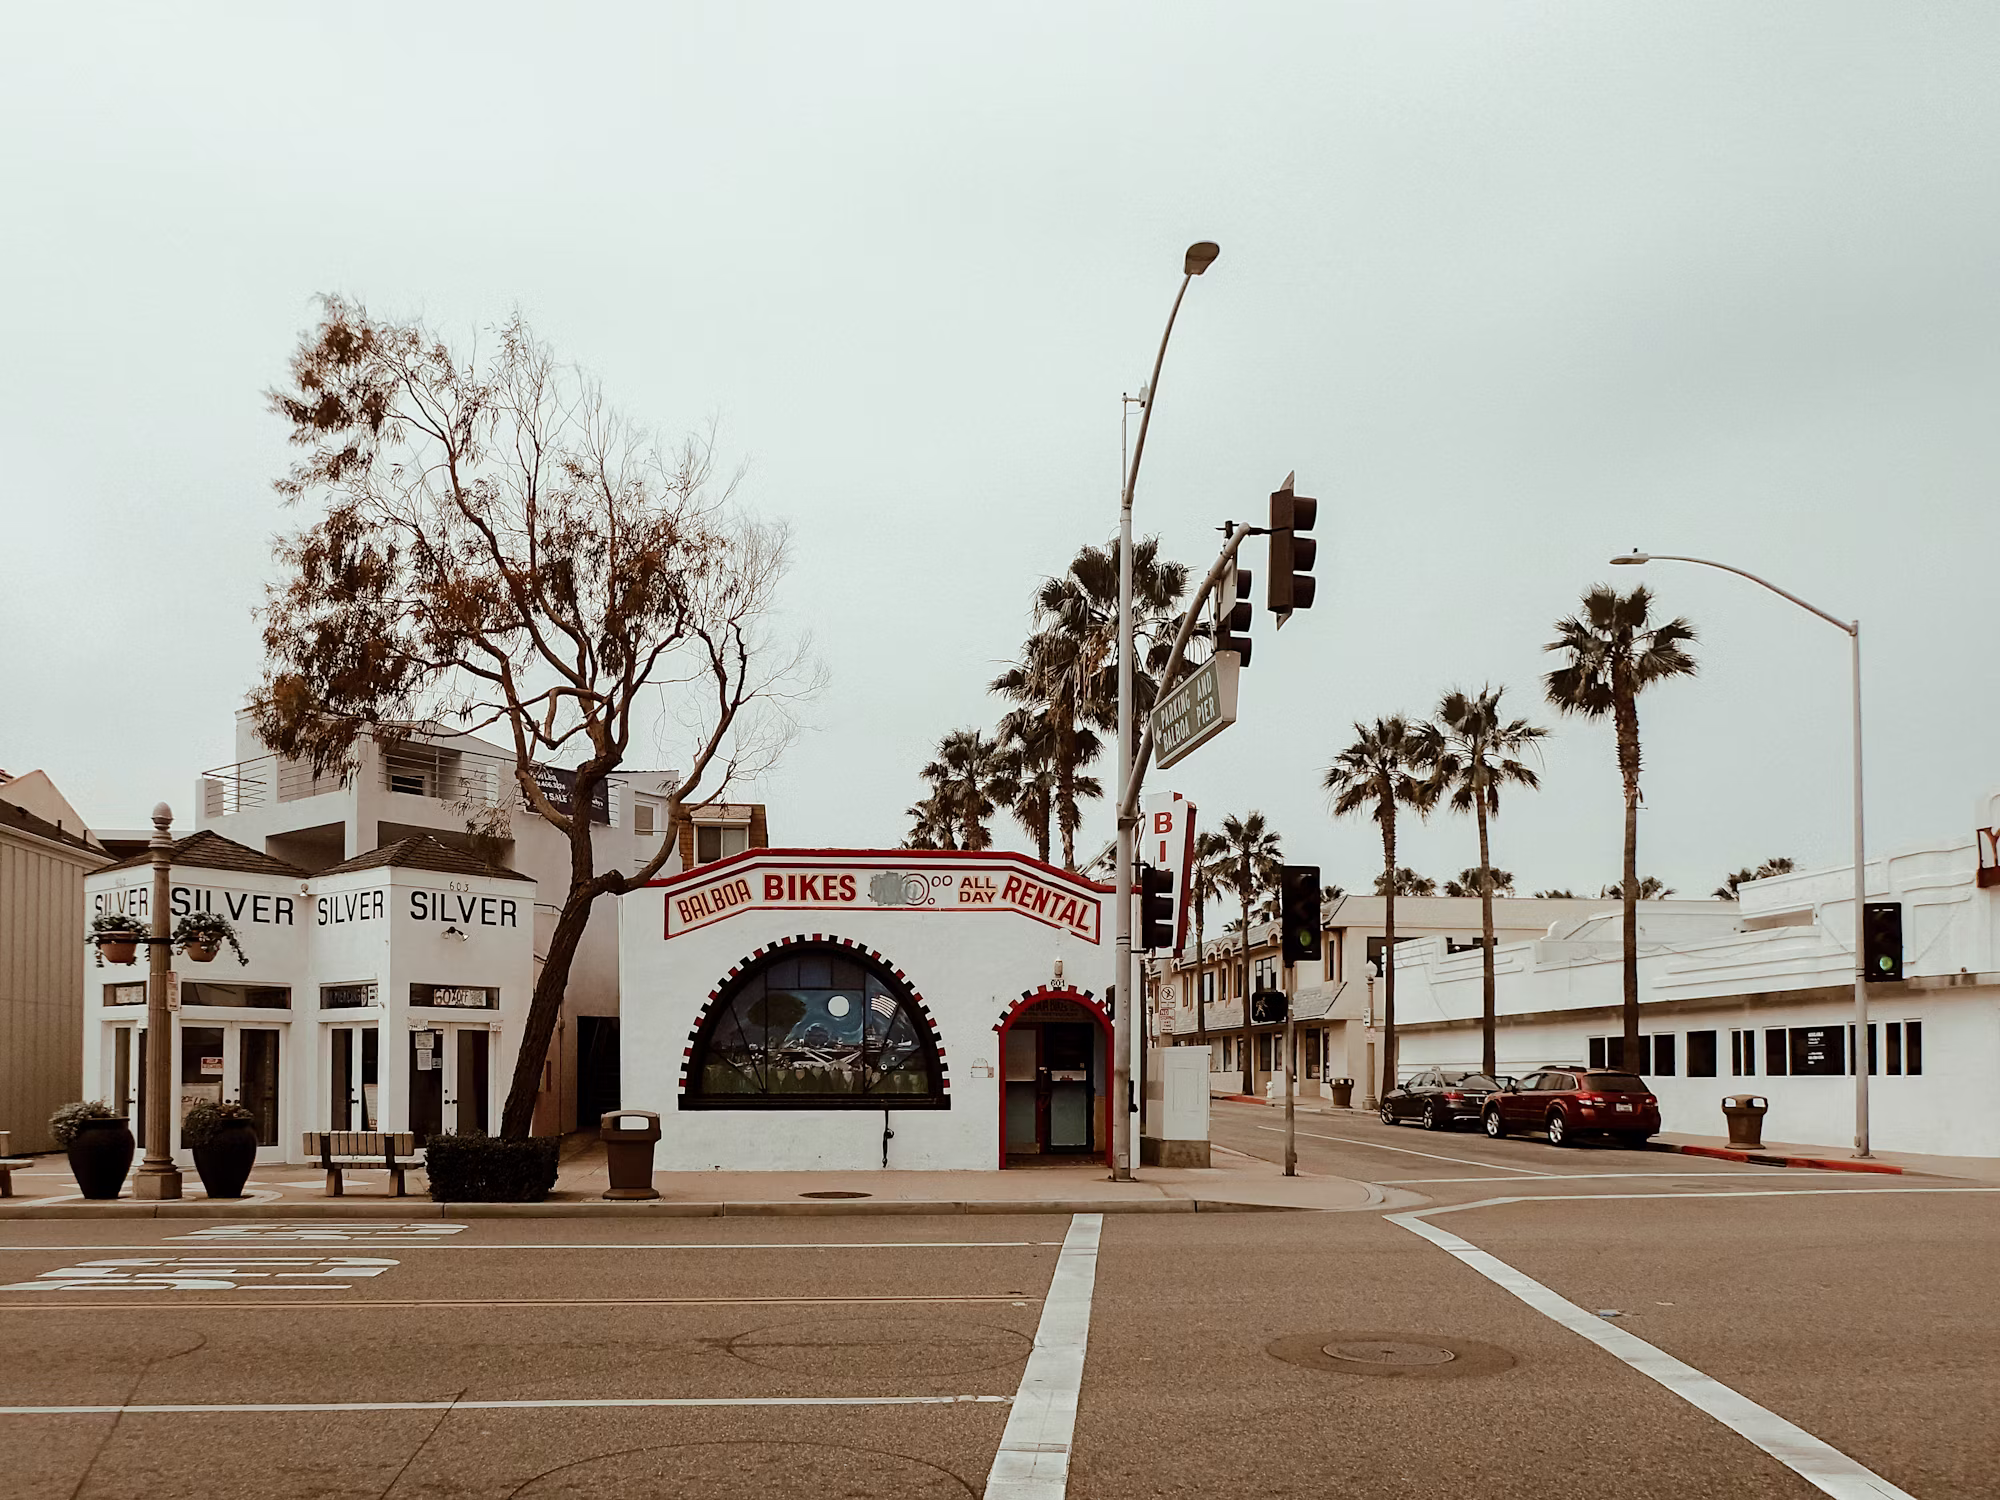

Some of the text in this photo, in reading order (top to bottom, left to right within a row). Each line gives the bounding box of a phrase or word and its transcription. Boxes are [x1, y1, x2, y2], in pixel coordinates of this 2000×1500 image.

[1161, 671, 1212, 730] PARKING AND
[1162, 696, 1215, 753] BALBOA PIER
[549, 792, 568, 803] SALE
[449, 881, 469, 892] 603
[676, 879, 752, 924] BALBOA
[764, 874, 857, 901] BIKES
[959, 891, 996, 903] DAY
[960, 877, 996, 889] ALL
[95, 887, 148, 917] SILVER
[170, 886, 294, 925] SILVER
[317, 889, 384, 926] SILVER
[410, 890, 517, 928] SILVER
[1001, 875, 1090, 932] RENTAL
[1050, 978, 1066, 988] 601
